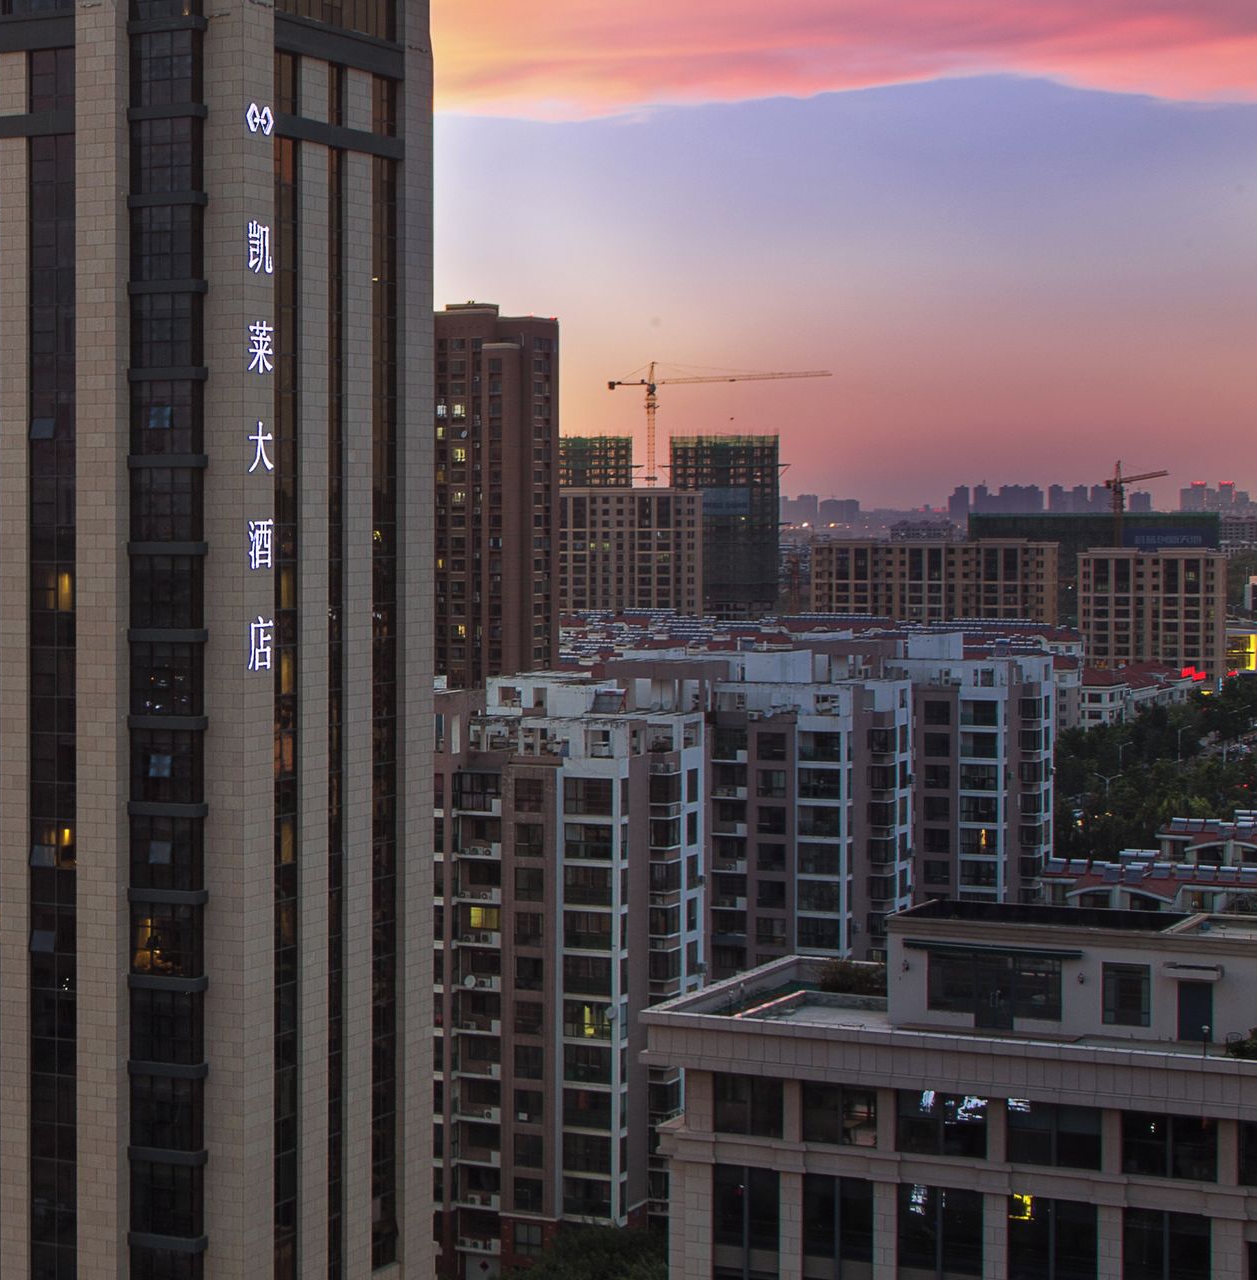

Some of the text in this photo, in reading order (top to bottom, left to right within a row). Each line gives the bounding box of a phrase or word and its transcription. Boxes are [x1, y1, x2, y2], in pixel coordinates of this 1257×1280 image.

[248, 220, 274, 671] 凯莱大酒店
